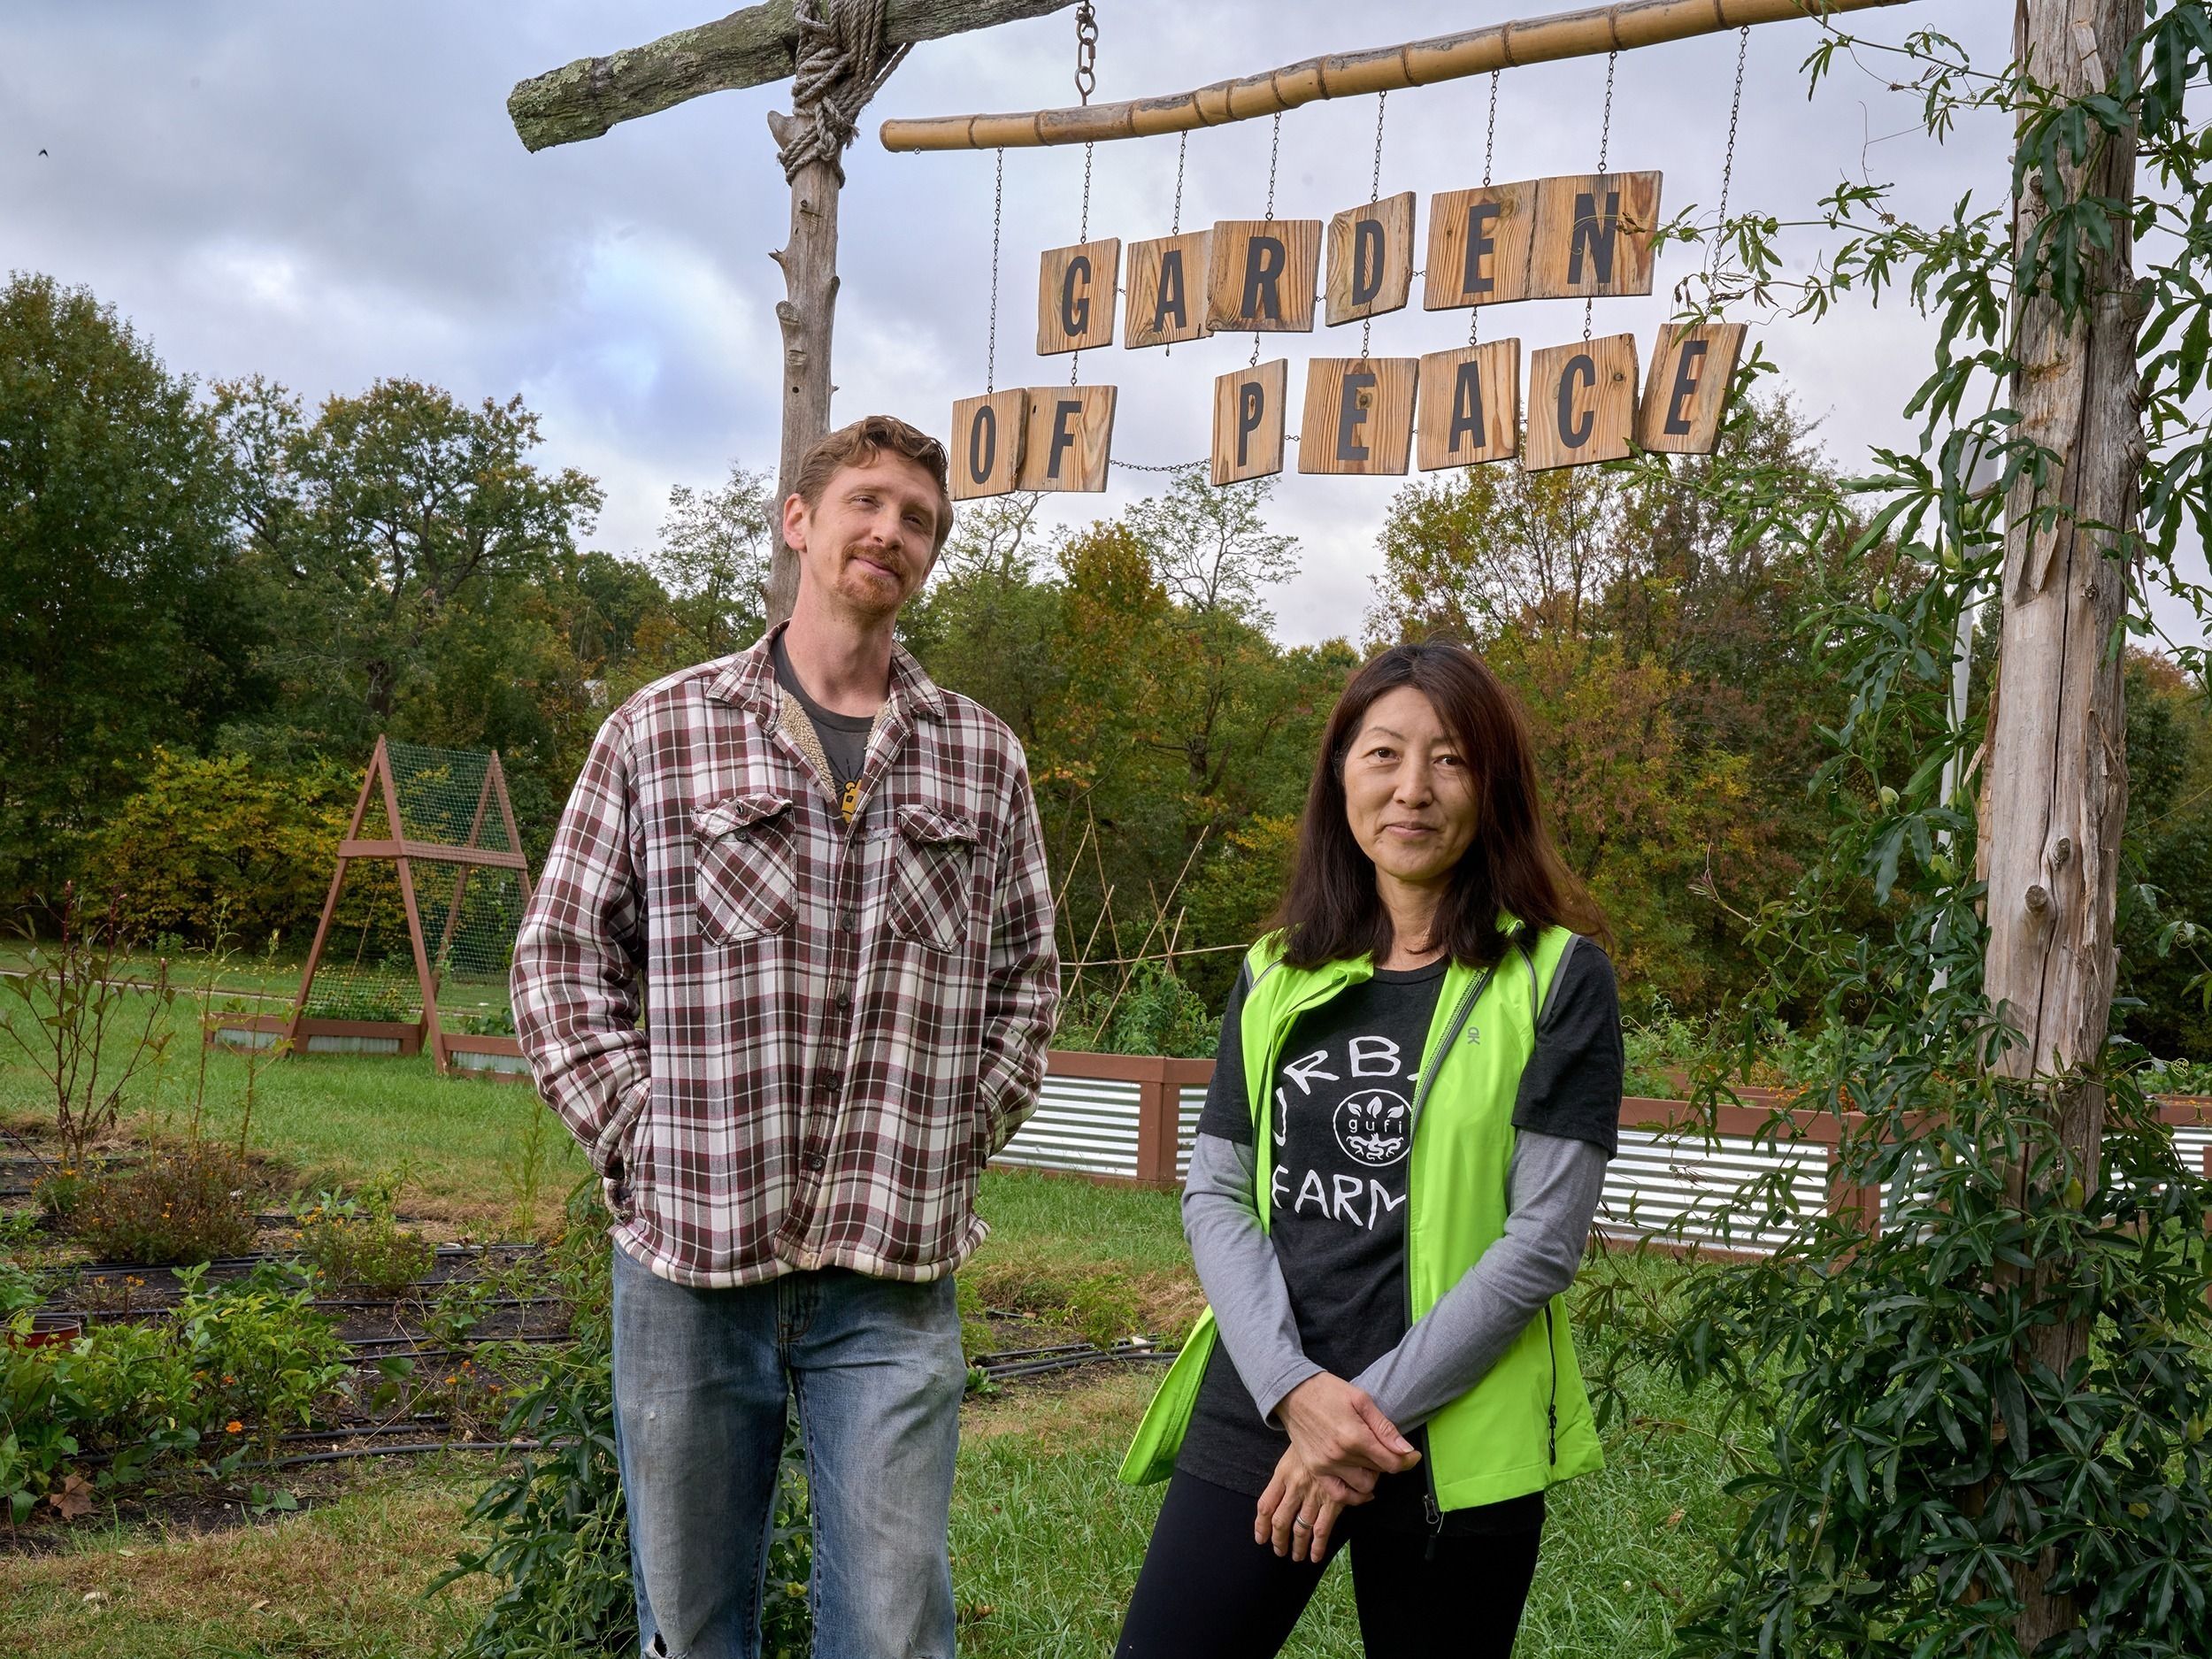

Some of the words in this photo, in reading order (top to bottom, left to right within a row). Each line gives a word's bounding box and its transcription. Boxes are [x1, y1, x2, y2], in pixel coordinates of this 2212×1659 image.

[1061, 191, 1621, 337] GARDEN
[970, 400, 1082, 485] OF
[1236, 339, 1711, 467] PEACE
[1348, 1118, 1402, 1133] gufi
